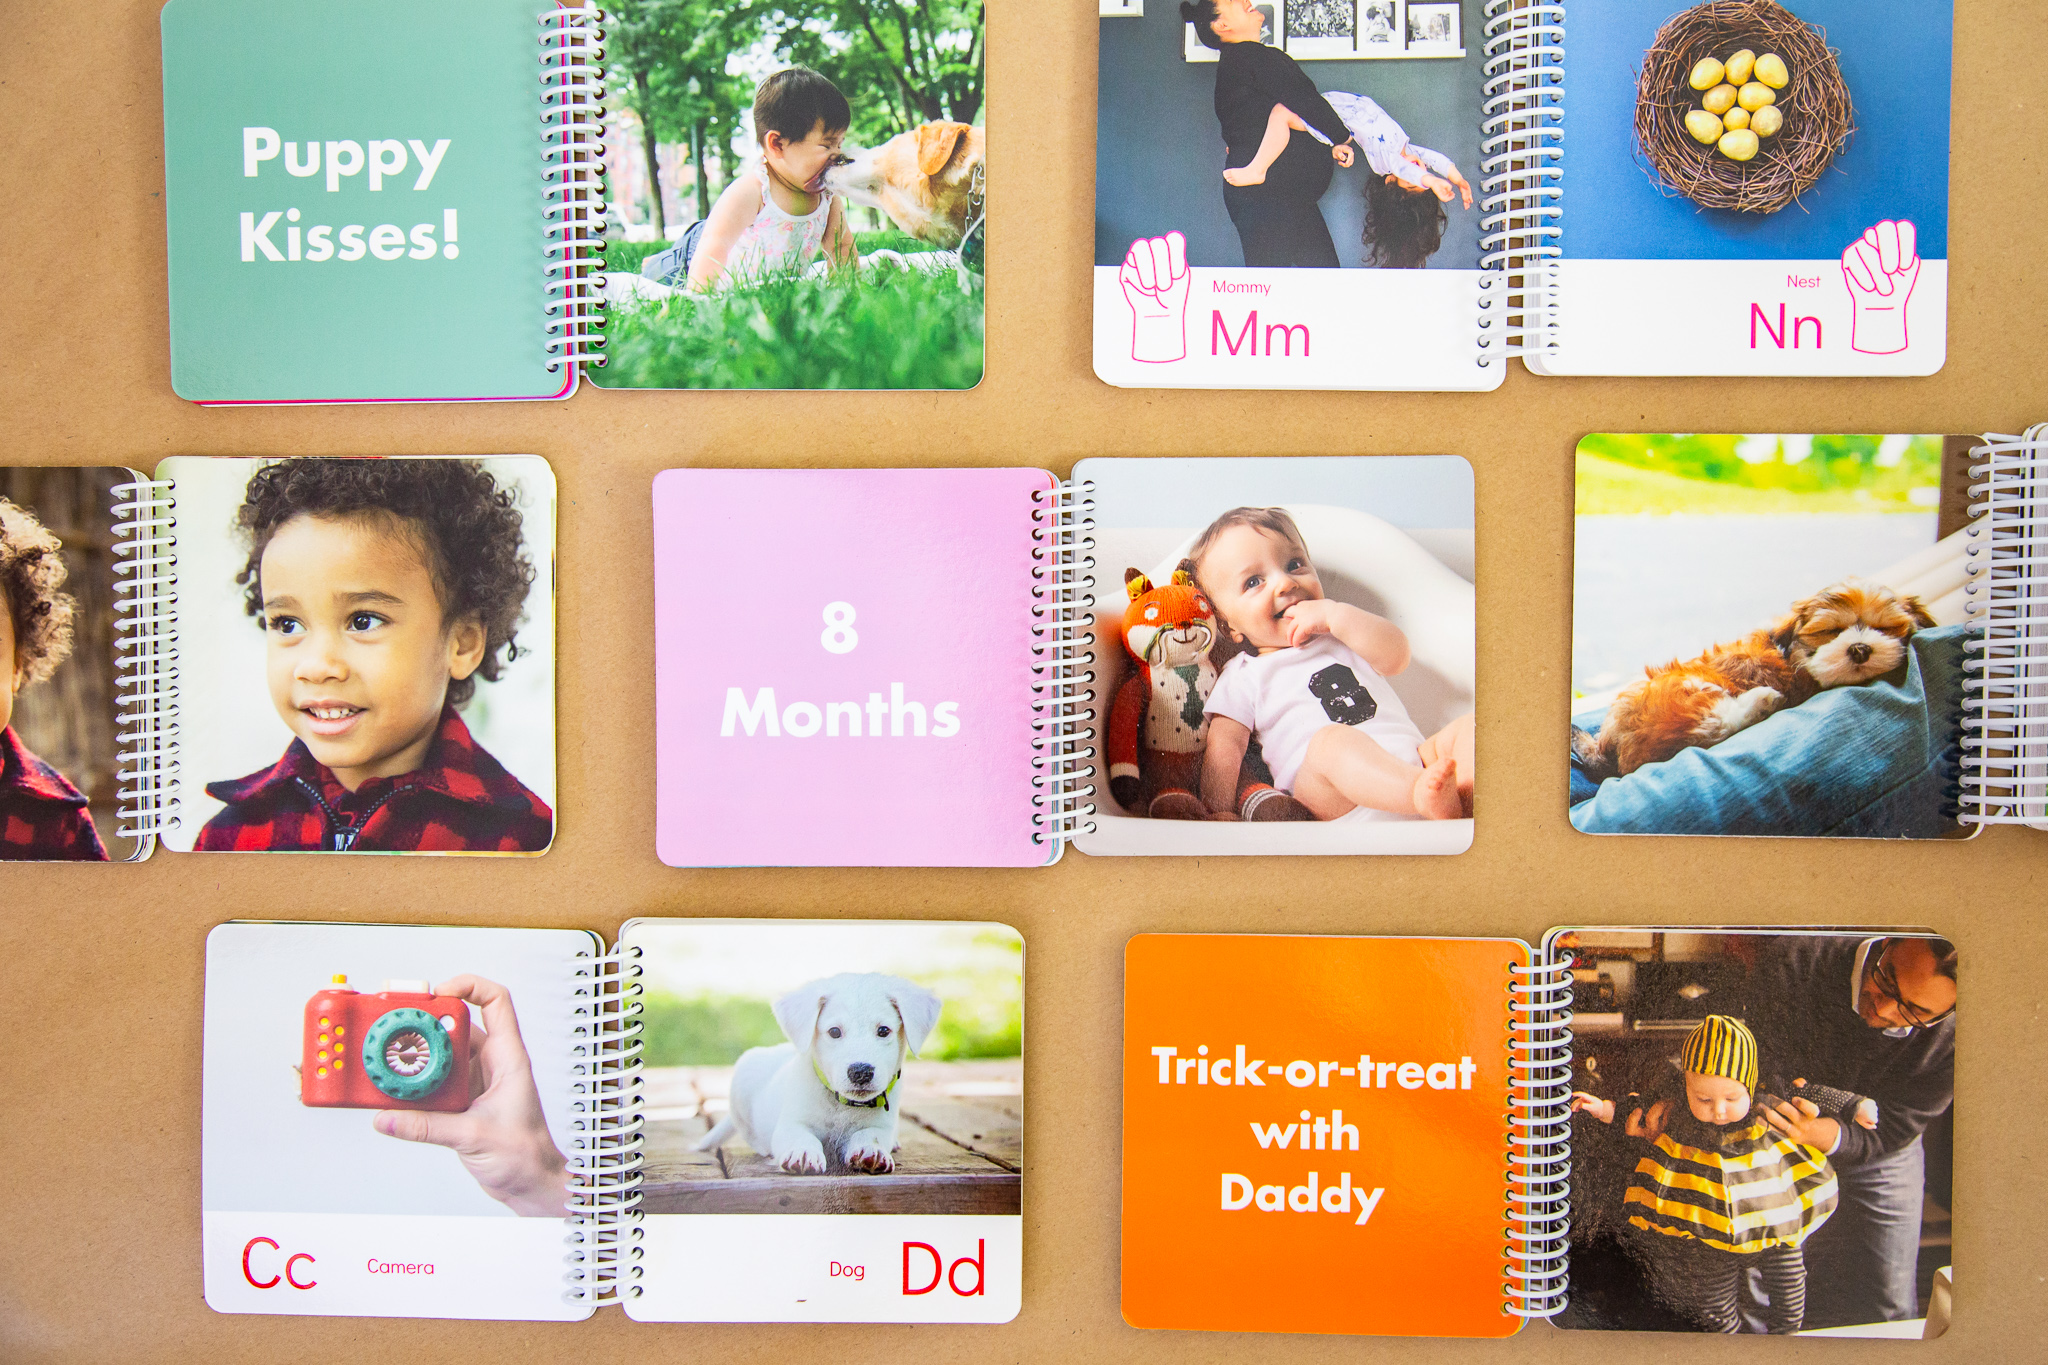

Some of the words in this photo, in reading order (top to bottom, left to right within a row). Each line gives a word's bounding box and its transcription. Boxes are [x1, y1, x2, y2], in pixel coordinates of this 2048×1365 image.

[243, 126, 452, 192] Puppy
[240, 207, 460, 262] Kisses!
[1212, 279, 1271, 296] Mommy
[1787, 274, 1821, 289] Nest
[1211, 309, 1310, 357] Mm
[1750, 302, 1823, 350] Nn
[820, 601, 859, 655] 8
[720, 682, 961, 738] Months
[1151, 1044, 1477, 1091] Trick-or-treat
[1249, 1109, 1360, 1151] with
[1220, 1171, 1385, 1226] Daddy
[241, 1236, 318, 1291] Cc
[367, 1257, 435, 1276] Camera
[829, 1260, 865, 1283] Dog
[901, 1237, 985, 1298] Dd
